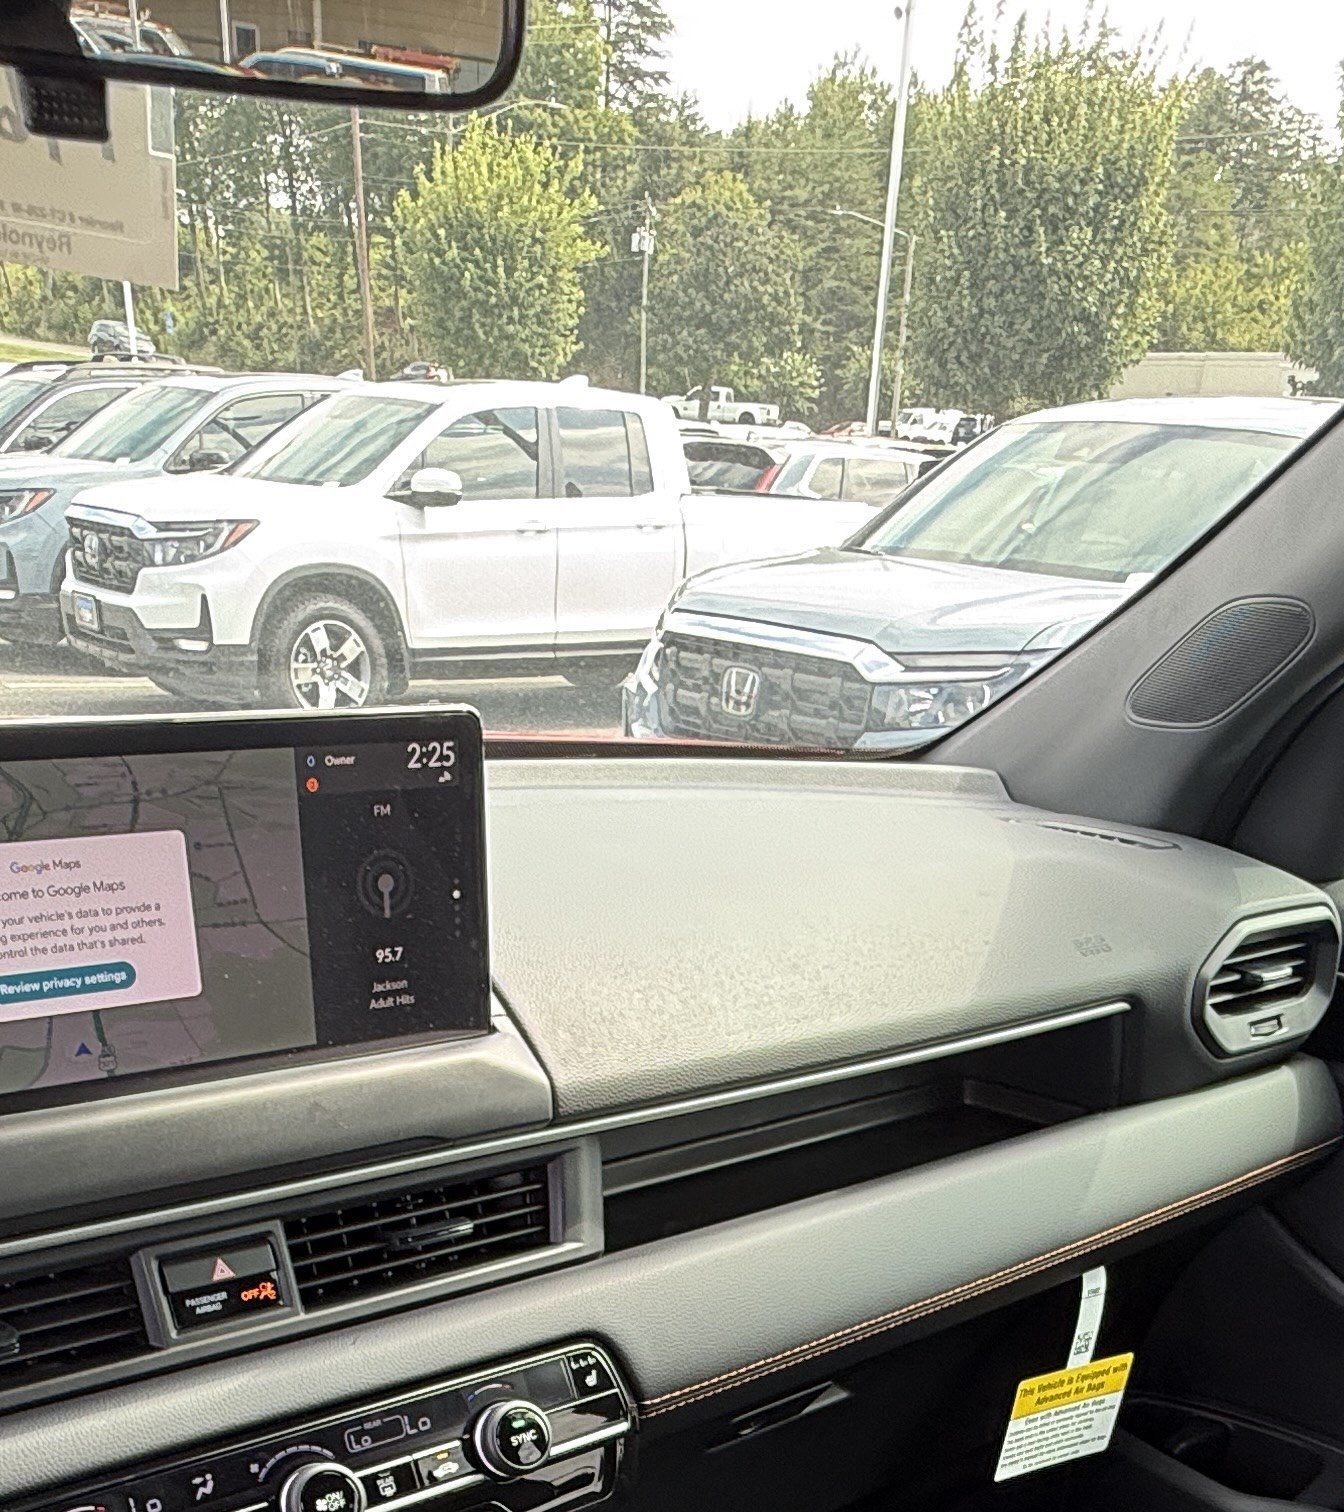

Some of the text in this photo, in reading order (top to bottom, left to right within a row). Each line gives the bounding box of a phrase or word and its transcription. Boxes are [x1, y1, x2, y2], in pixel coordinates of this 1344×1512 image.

[324, 741, 456, 769] Owner 2:25
[373, 804, 391, 817] FM
[10, 858, 82, 875] Google Maps
[31, 886, 46, 899] to
[47, 883, 91, 899] Google
[92, 879, 126, 896] Maps
[1, 915, 25, 930] your
[27, 909, 74, 925] vehicle's
[75, 907, 99, 920] data
[101, 905, 113, 917] to
[114, 902, 152, 917] provide
[154, 902, 162, 913] a
[9, 926, 69, 943] experience
[70, 924, 85, 936] for
[87, 923, 108, 937] you
[110, 920, 129, 932] and
[130, 916, 166, 930] others.
[30, 945, 49, 957] the
[50, 943, 76, 955] data
[76, 938, 107, 953] that's
[108, 934, 147, 949] shared.
[375, 946, 404, 964] 95.7
[42, 975, 82, 994] privacy
[84, 969, 128, 987] settings
[371, 979, 409, 994] Jackson
[369, 993, 416, 1010] Adult Hits
[240, 1288, 260, 1302] OFF
[1019, 1388, 1036, 1399] This
[1037, 1378, 1065, 1393] Vehicle
[1067, 1376, 1074, 1385] is
[1076, 1366, 1112, 1384] Equipped
[1034, 1380, 1106, 1407] Advanced Air Bags
[510, 1429, 537, 1447] SYNC
